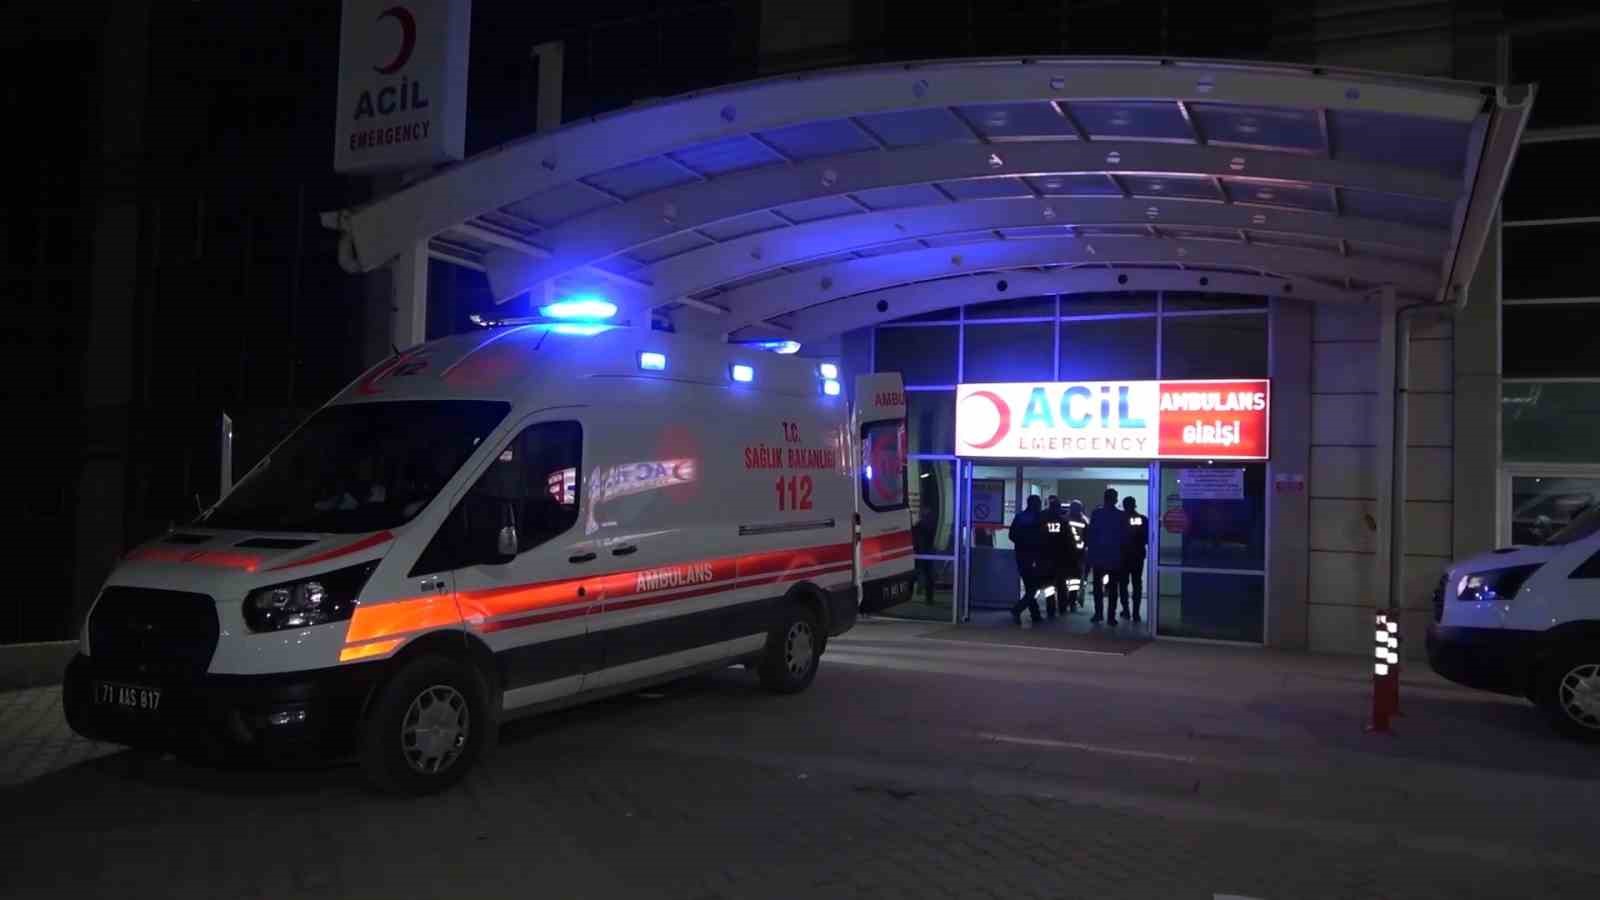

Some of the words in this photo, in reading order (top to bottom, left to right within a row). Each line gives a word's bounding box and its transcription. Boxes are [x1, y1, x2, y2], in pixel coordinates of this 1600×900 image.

[354, 75, 428, 120] ACİL
[350, 120, 430, 151] EMERGENCY
[1020, 386, 1146, 429] ACİL
[1159, 392, 1266, 412] AMBULANS
[782, 422, 801, 442] T.C.
[1018, 437, 1148, 451] EMERGENCY
[1182, 420, 1241, 445] GİRİŞİ
[744, 444, 784, 469] SAĞLIK
[774, 475, 813, 511] 112
[1047, 522, 1062, 533] 112
[635, 563, 713, 594] AMBULANS
[103, 684, 114, 704] 71
